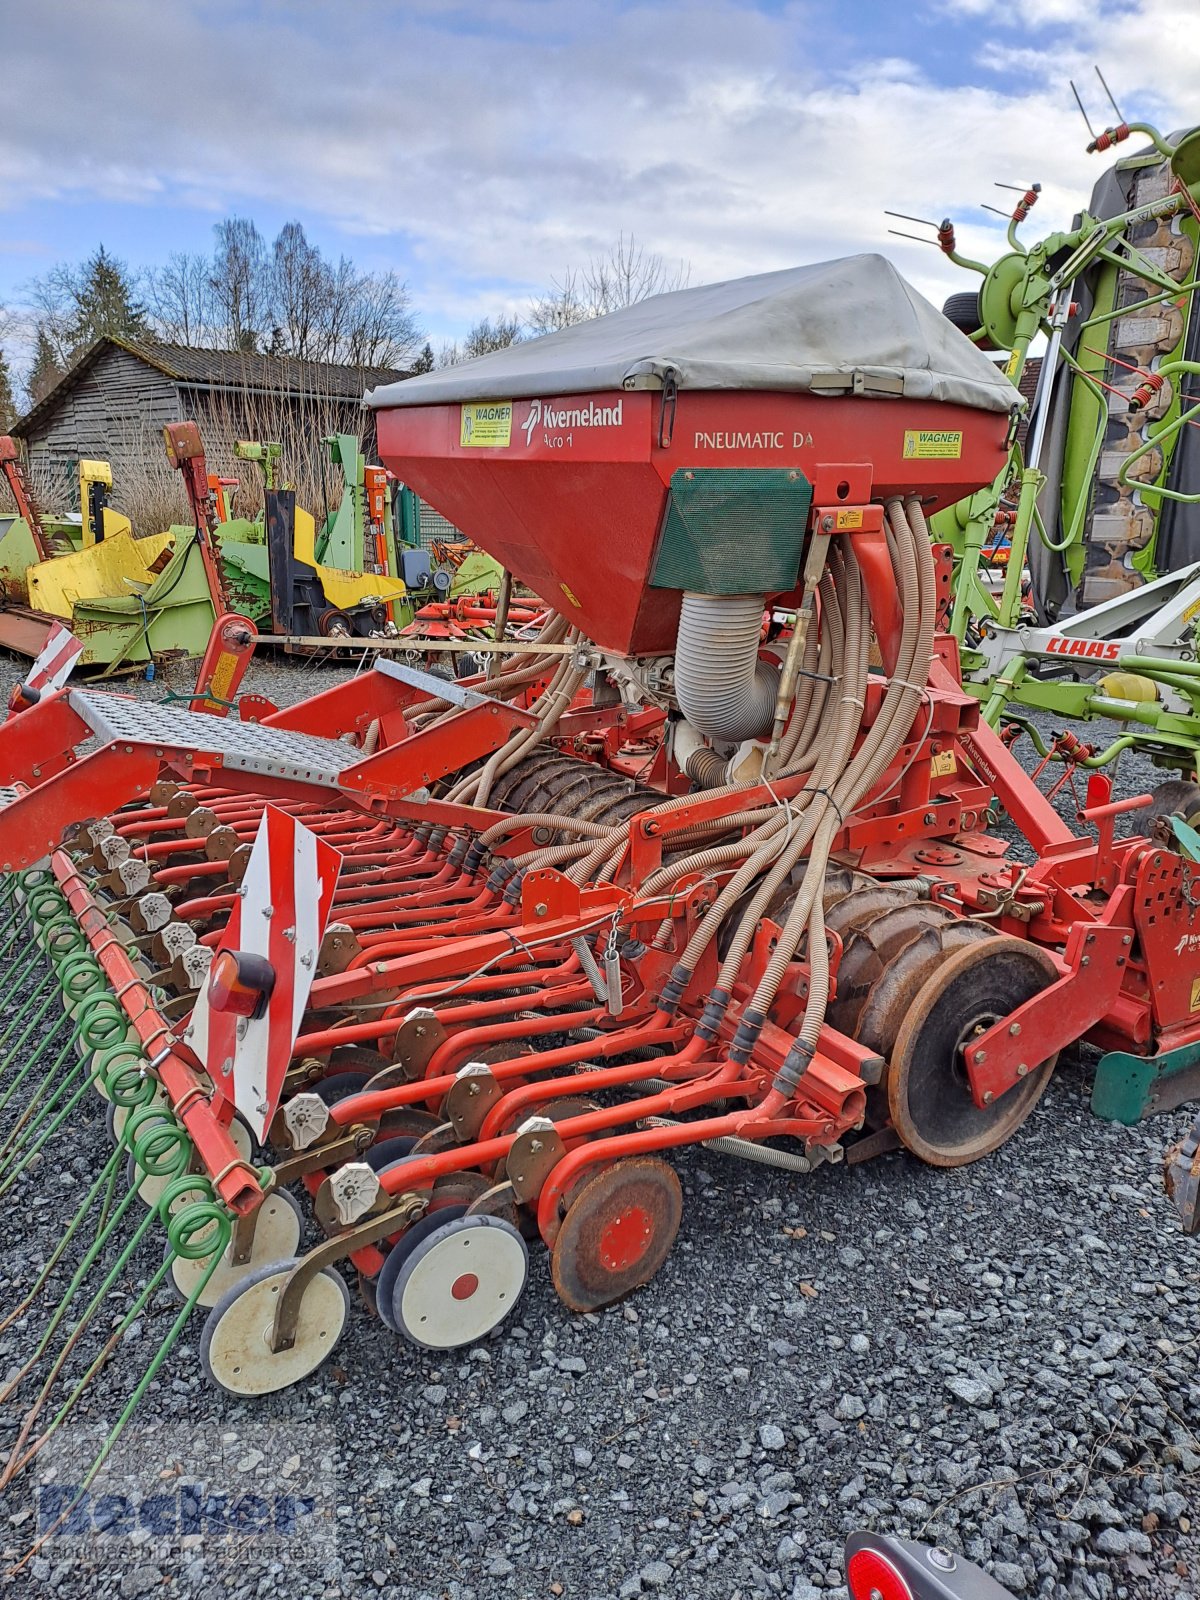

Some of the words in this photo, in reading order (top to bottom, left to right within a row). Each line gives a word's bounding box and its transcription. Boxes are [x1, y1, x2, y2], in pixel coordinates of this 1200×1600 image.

[475, 407, 511, 420] WAGNER
[544, 400, 622, 428] Kverneland
[694, 432, 784, 448] PNEUMATIC
[919, 433, 960, 443] WAGNER
[1046, 638, 1121, 660] CLAAS
[967, 741, 997, 783] Kverneland
